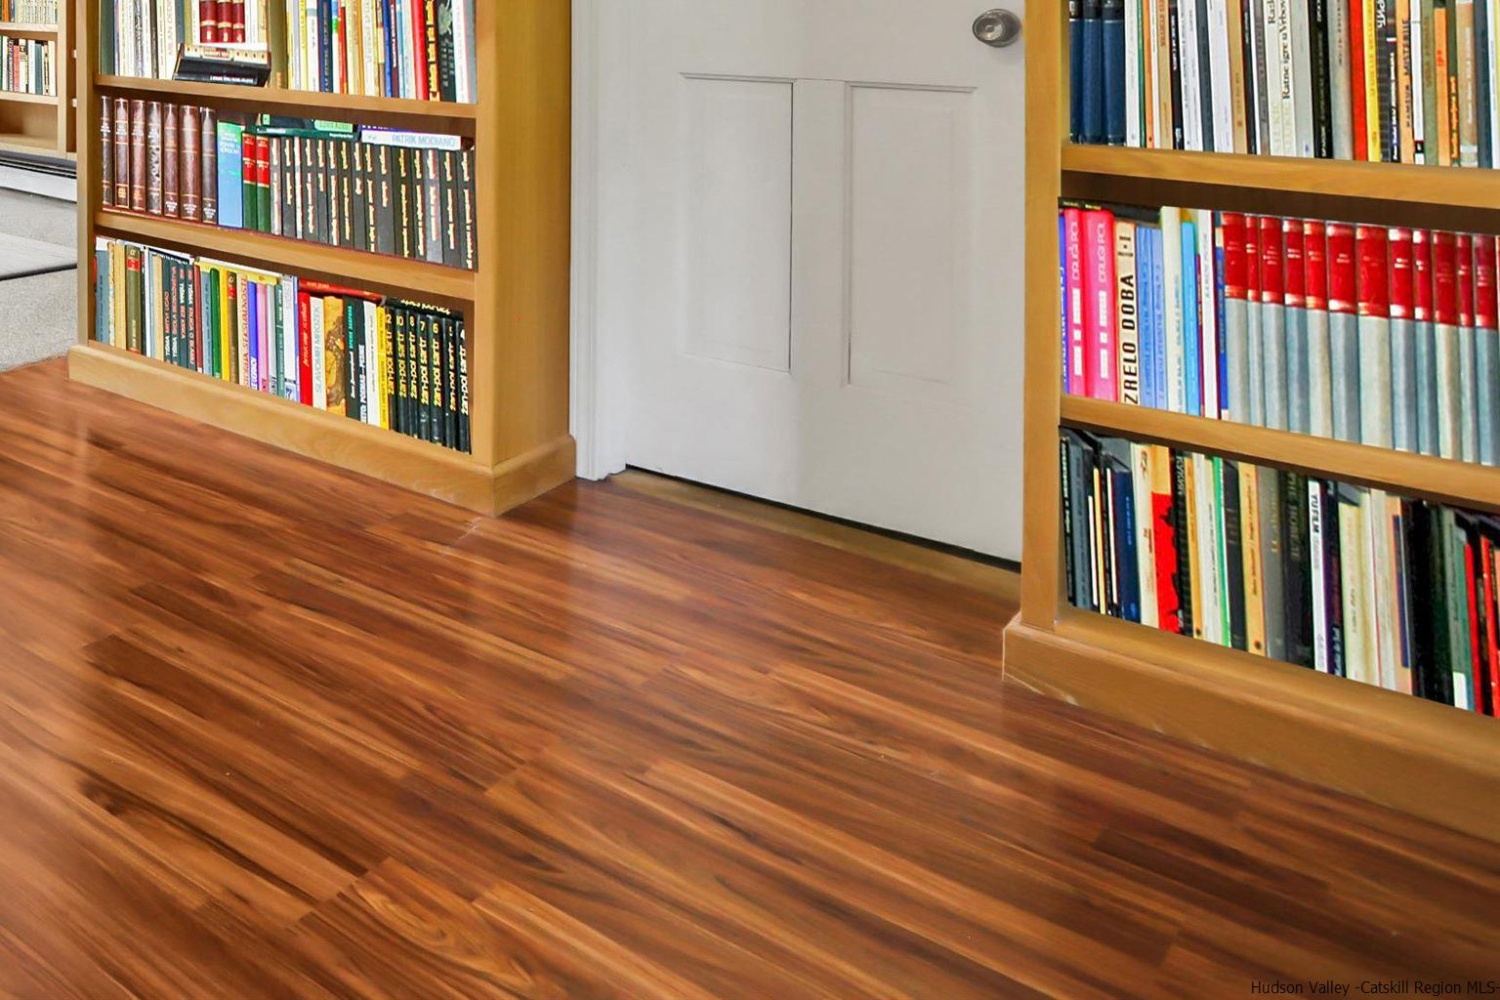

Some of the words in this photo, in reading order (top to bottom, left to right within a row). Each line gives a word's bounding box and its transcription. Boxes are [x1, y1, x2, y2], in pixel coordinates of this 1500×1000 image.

[1281, 43, 1290, 64] igre
[1282, 66, 1290, 99] Ratne
[392, 135, 416, 144] PATRIK
[418, 136, 455, 147] MODIANO
[1121, 274, 1135, 331] DOBA
[420, 321, 426, 331] 7
[397, 331, 405, 358] sartr
[419, 337, 427, 364] sartr
[432, 339, 440, 366] sartr
[459, 345, 467, 374] sartr
[1122, 342, 1138, 404] ZRELO
